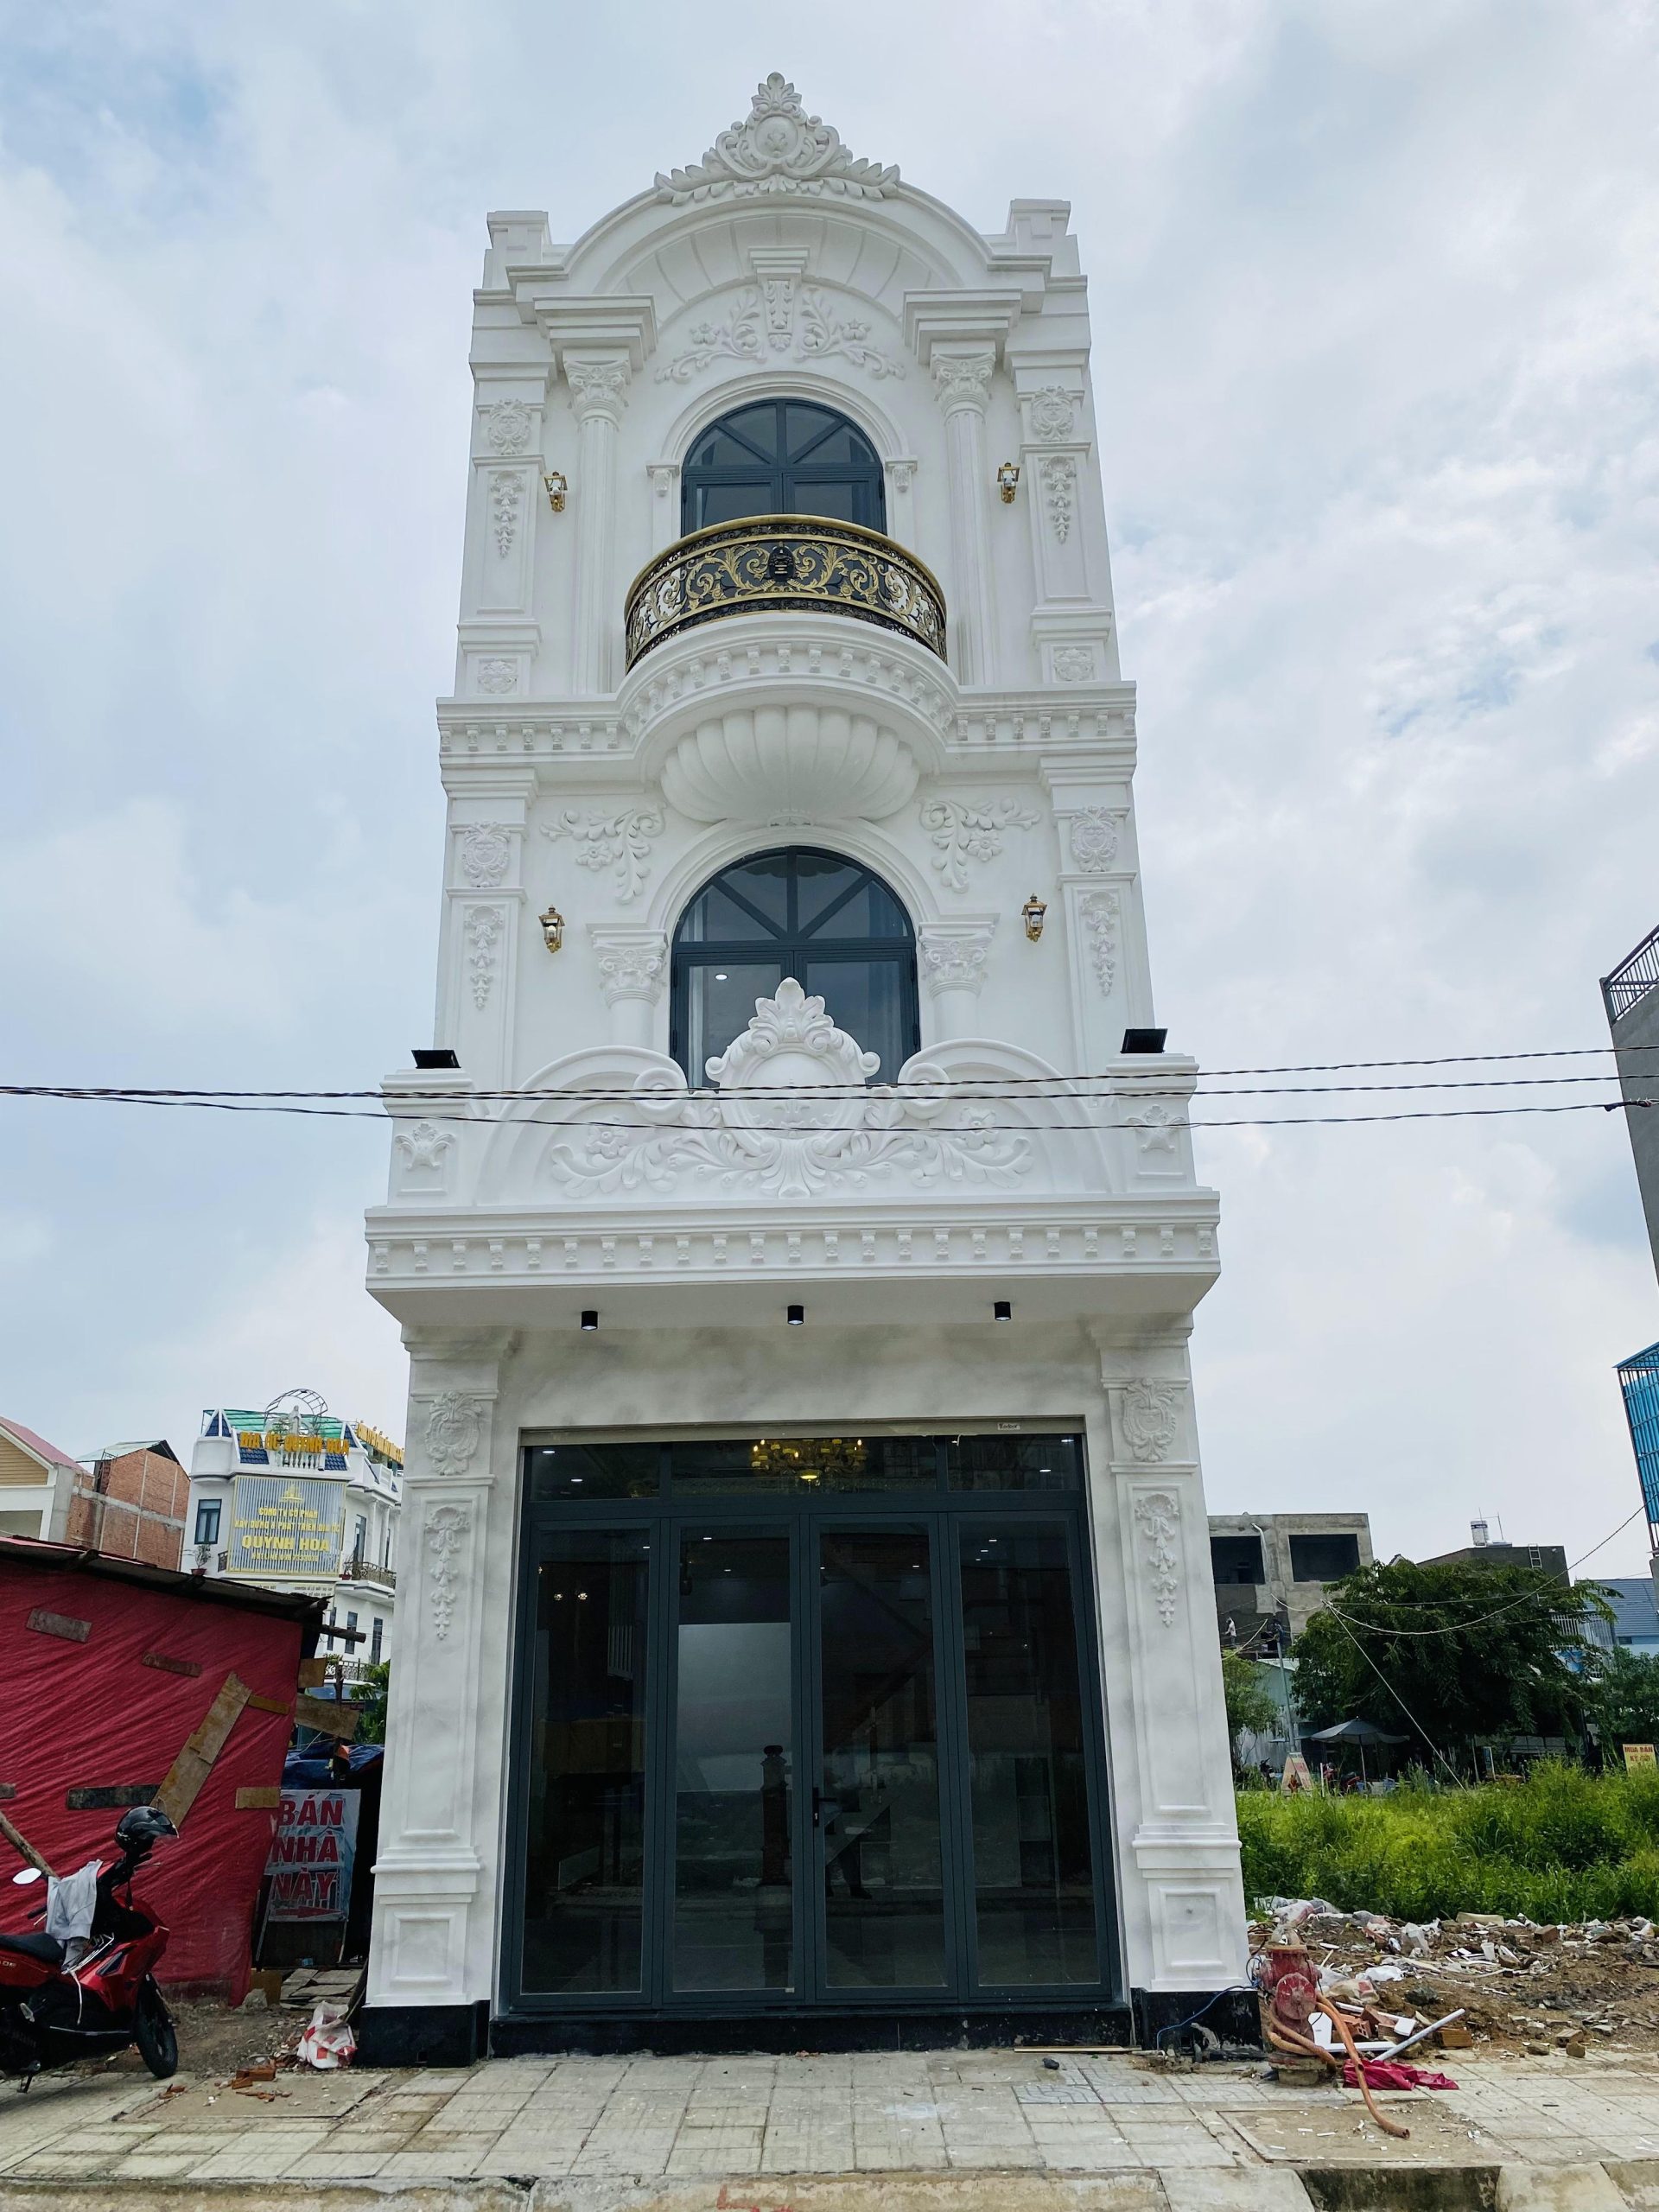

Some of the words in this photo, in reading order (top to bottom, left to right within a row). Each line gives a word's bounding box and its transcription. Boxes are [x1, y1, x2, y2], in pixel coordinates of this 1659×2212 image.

[242, 1532, 294, 1550] QUỲNH
[299, 1537, 329, 1553] HOA
[277, 1794, 345, 1826] BÁN
[271, 1830, 340, 1863] NHÀ
[273, 1867, 337, 1901] NÀY
